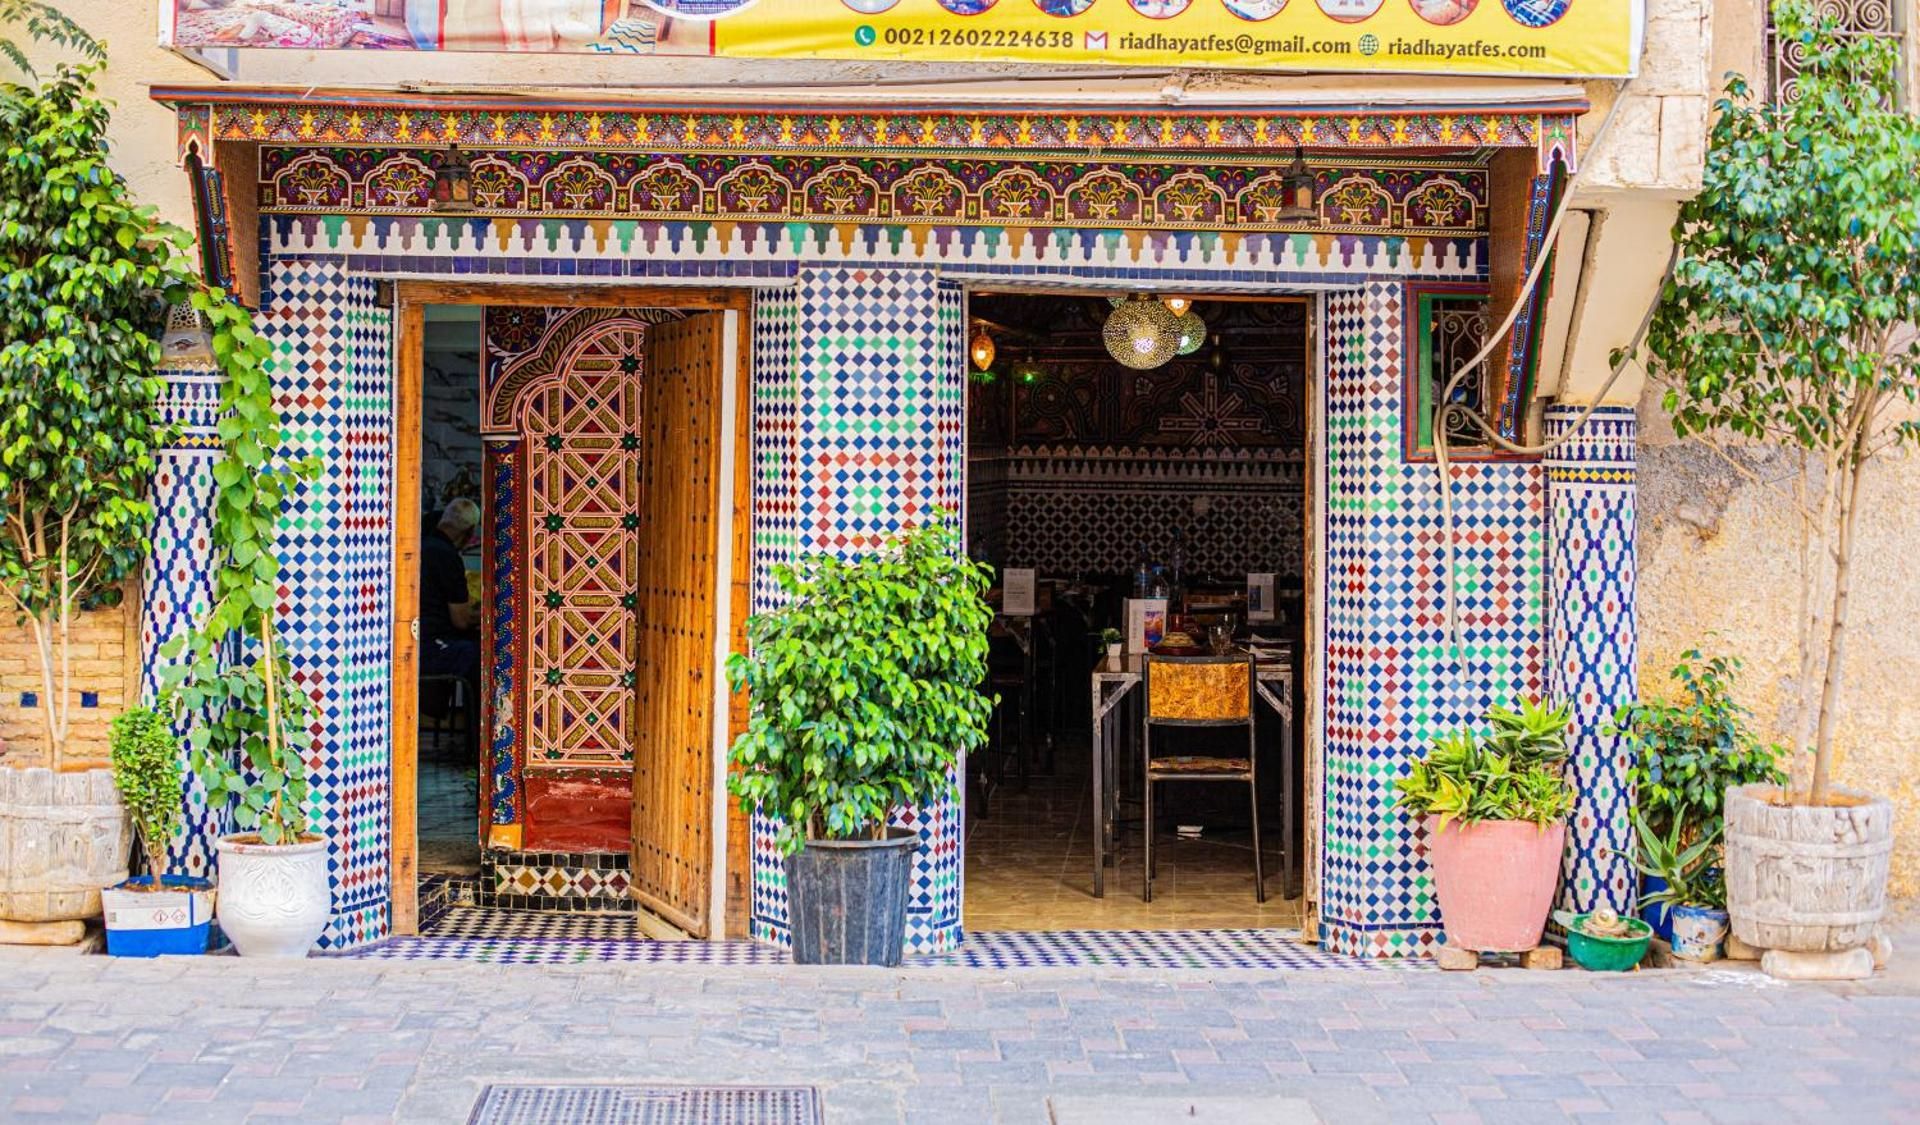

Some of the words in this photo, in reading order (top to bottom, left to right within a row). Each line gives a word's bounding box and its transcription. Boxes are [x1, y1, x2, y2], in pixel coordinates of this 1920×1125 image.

[884, 28, 1074, 48] 00212602224638
[1119, 32, 1351, 54] riadhayatfes@gmail.com
[1388, 38, 1546, 59] riadhayatfes.com
